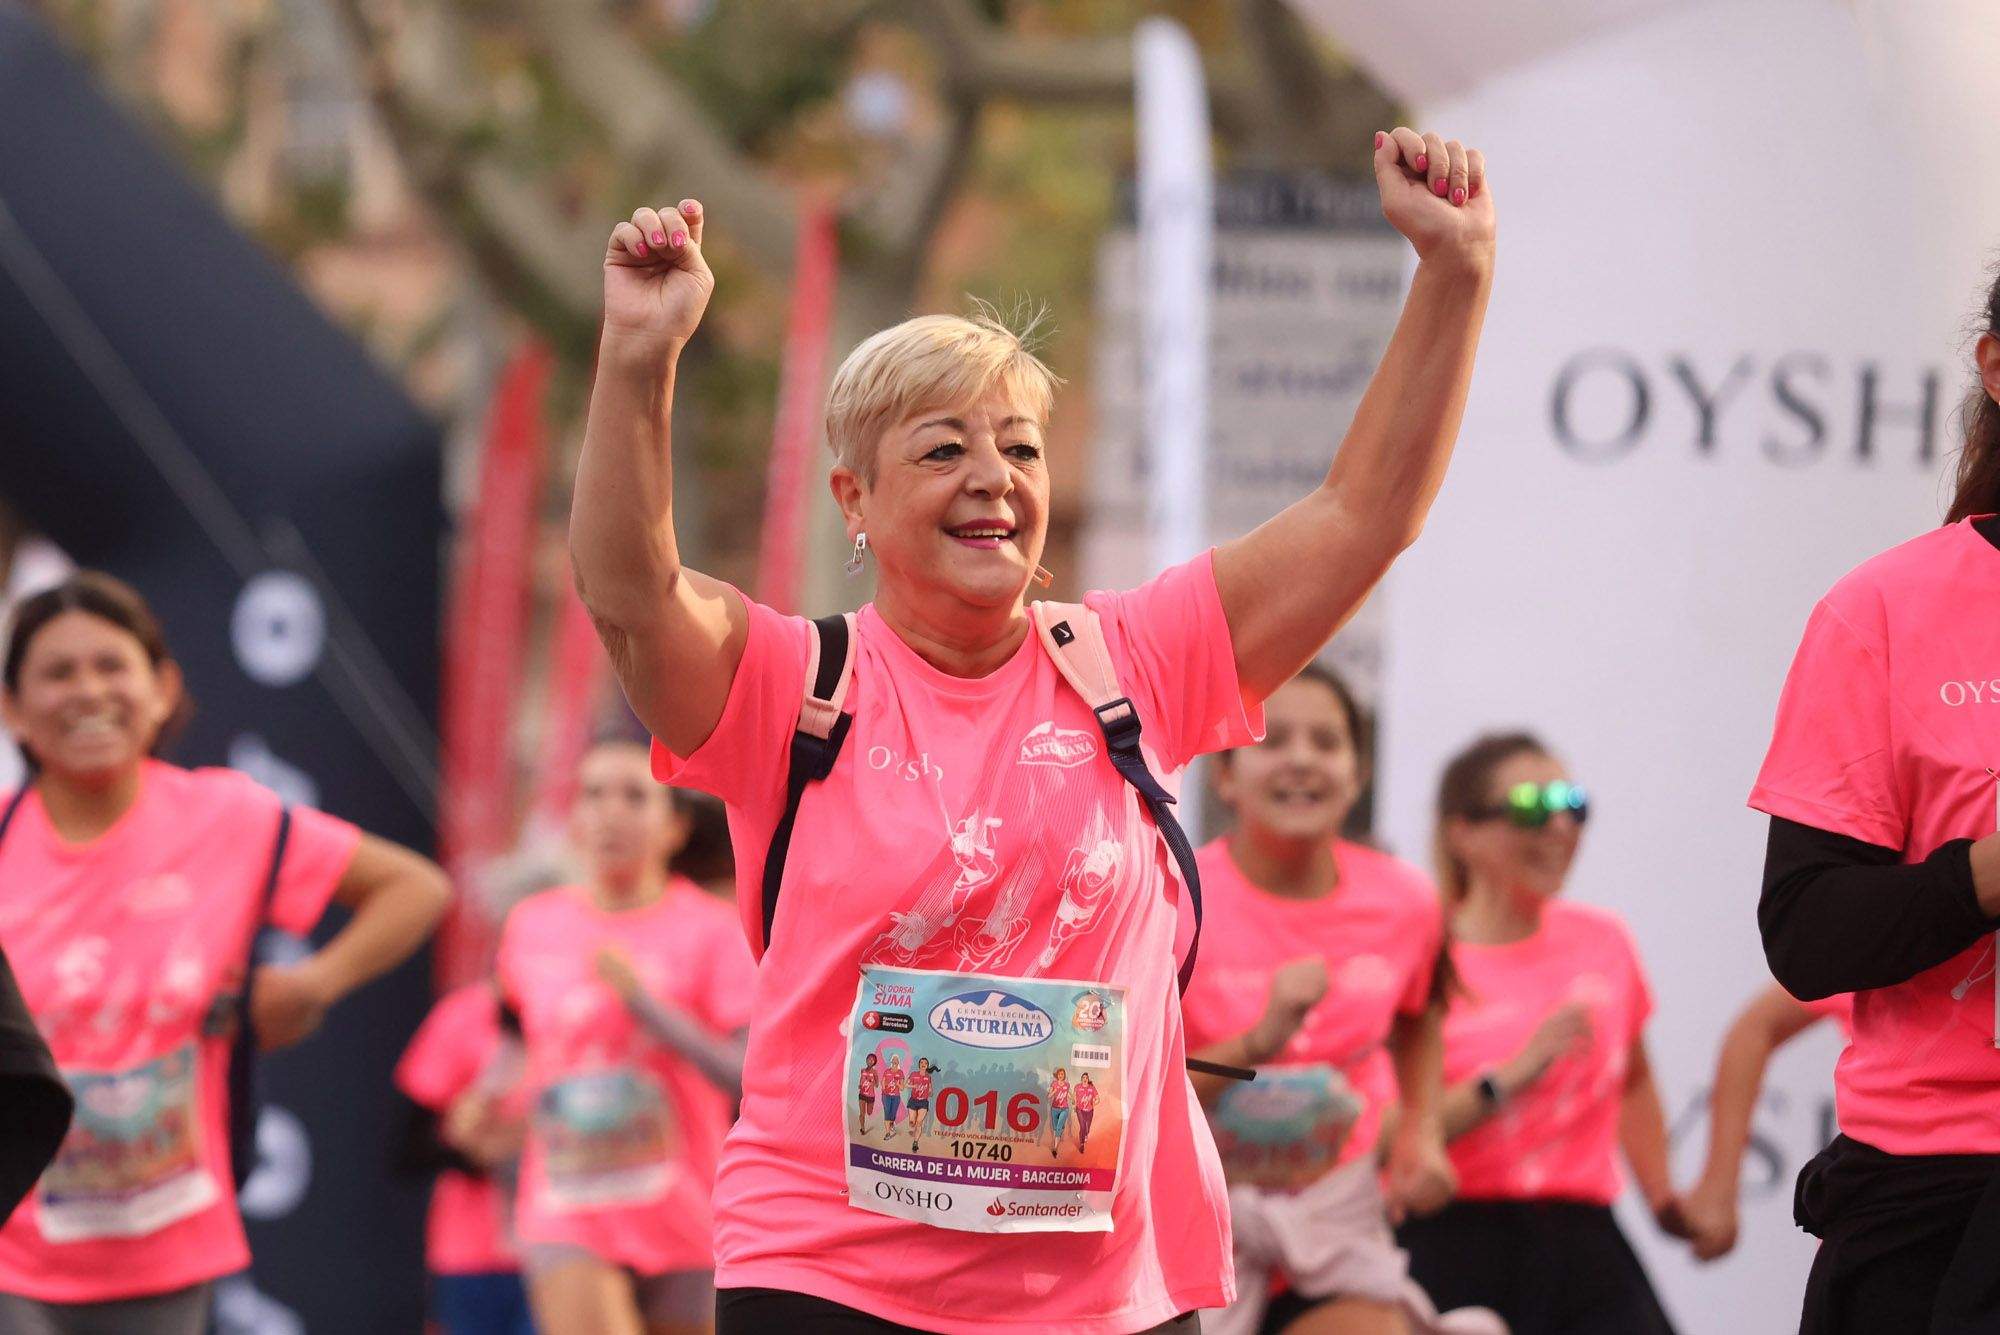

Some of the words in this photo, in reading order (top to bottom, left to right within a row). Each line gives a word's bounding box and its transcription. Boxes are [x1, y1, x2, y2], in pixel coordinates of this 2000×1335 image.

[873, 992, 912, 1008] SUMA
[888, 985, 915, 994] DORSAL
[937, 1007, 1044, 1038] ASTURIANA
[957, 1007, 998, 1017] CENTRAL
[1001, 1011, 1042, 1020] LECHERA
[935, 1086, 1041, 1133] 016
[950, 1140, 1012, 1161] 10740
[871, 1153, 923, 1174] CARRERA
[927, 1161, 943, 1176] DE
[947, 1163, 963, 1178] LA
[967, 1166, 1011, 1181] MUJER
[1022, 1170, 1091, 1184] BARCELONA
[875, 1182, 953, 1211] OYSHO
[1007, 1202, 1083, 1217] Santander
